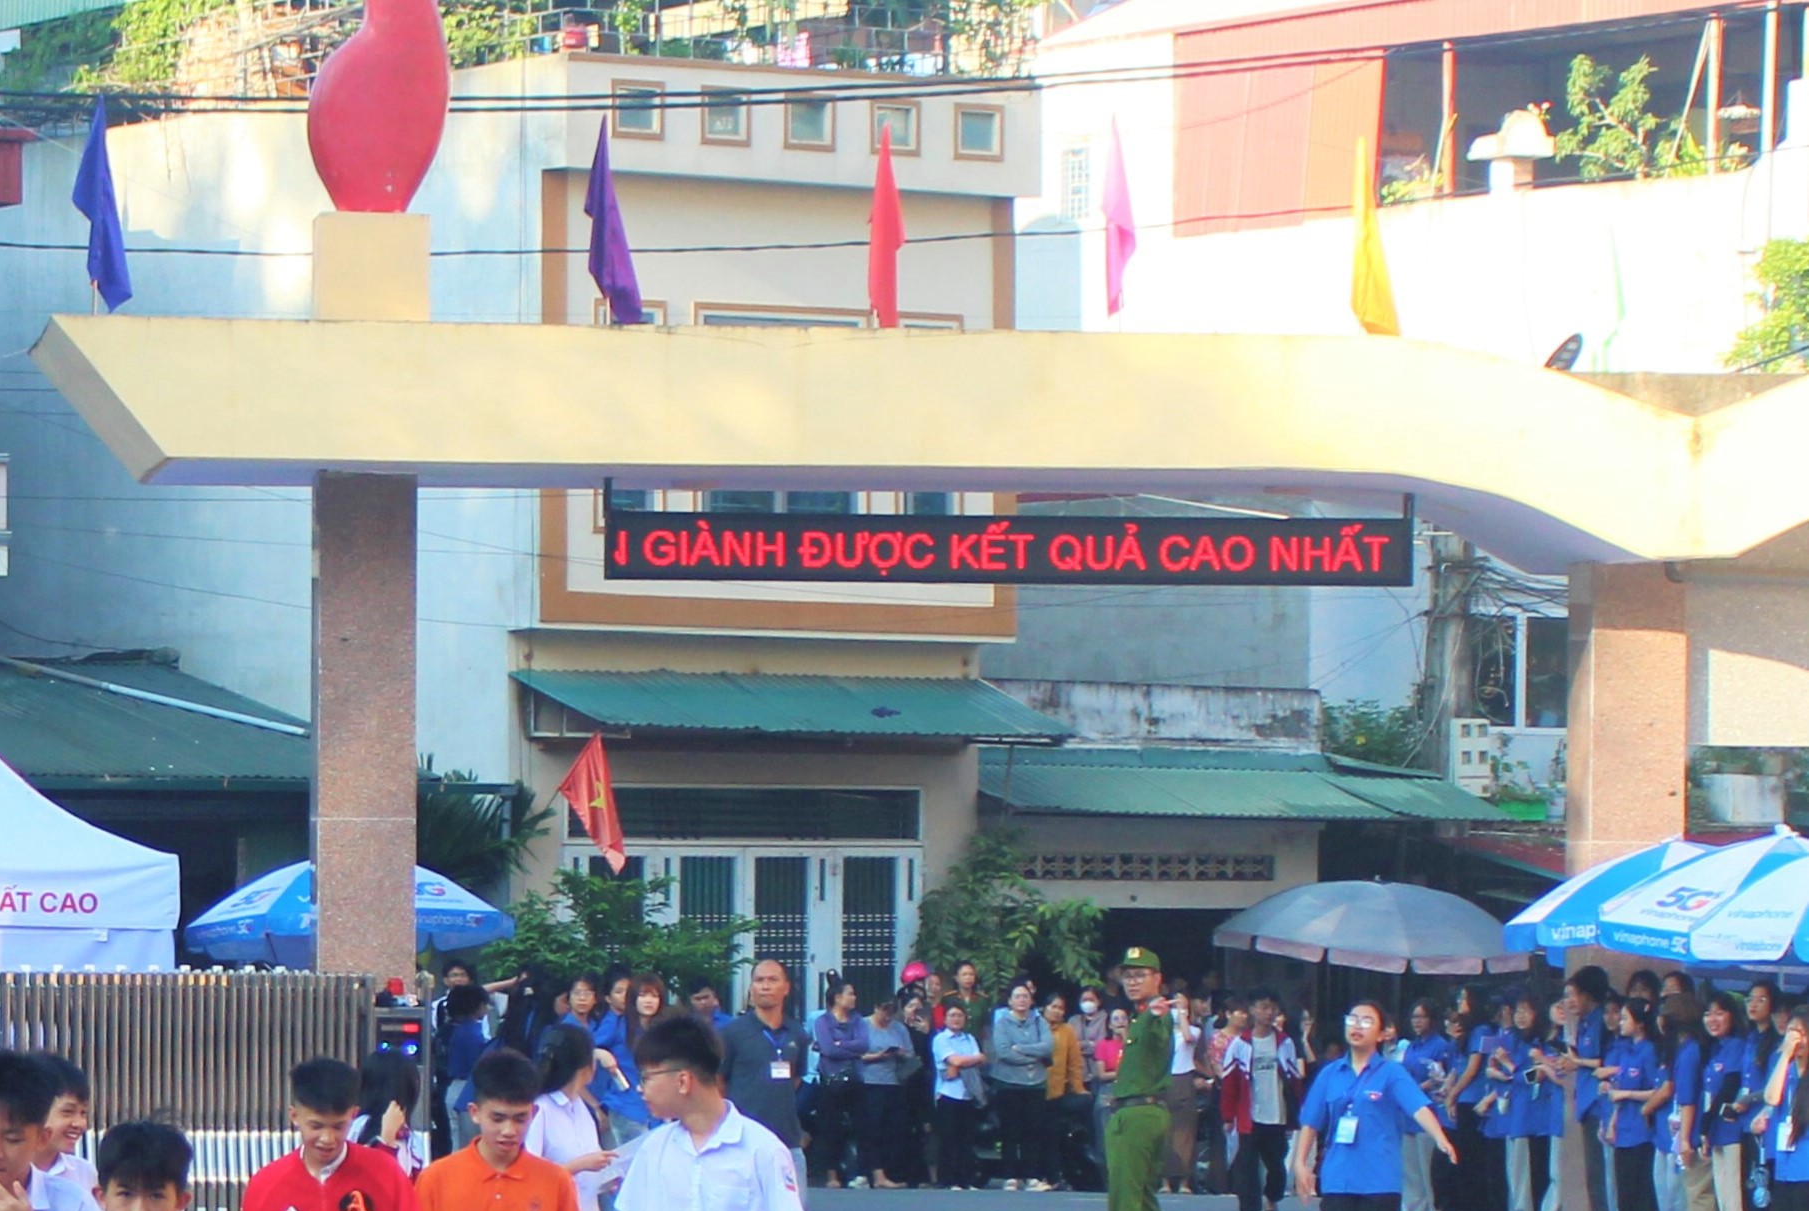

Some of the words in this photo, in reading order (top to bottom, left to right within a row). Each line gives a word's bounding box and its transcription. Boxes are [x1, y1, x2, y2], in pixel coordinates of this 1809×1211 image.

[642, 519, 787, 567] GIÀNH
[797, 529, 935, 577] ĐƯỢC
[949, 520, 1035, 571] KẾT
[1048, 522, 1148, 572] QUẢ
[1158, 534, 1257, 573] CAO
[1268, 523, 1391, 573] NHẤT
[39, 892, 99, 915] CAO
[1551, 922, 1600, 943] vinap
[1613, 929, 1670, 949] vinaphone
